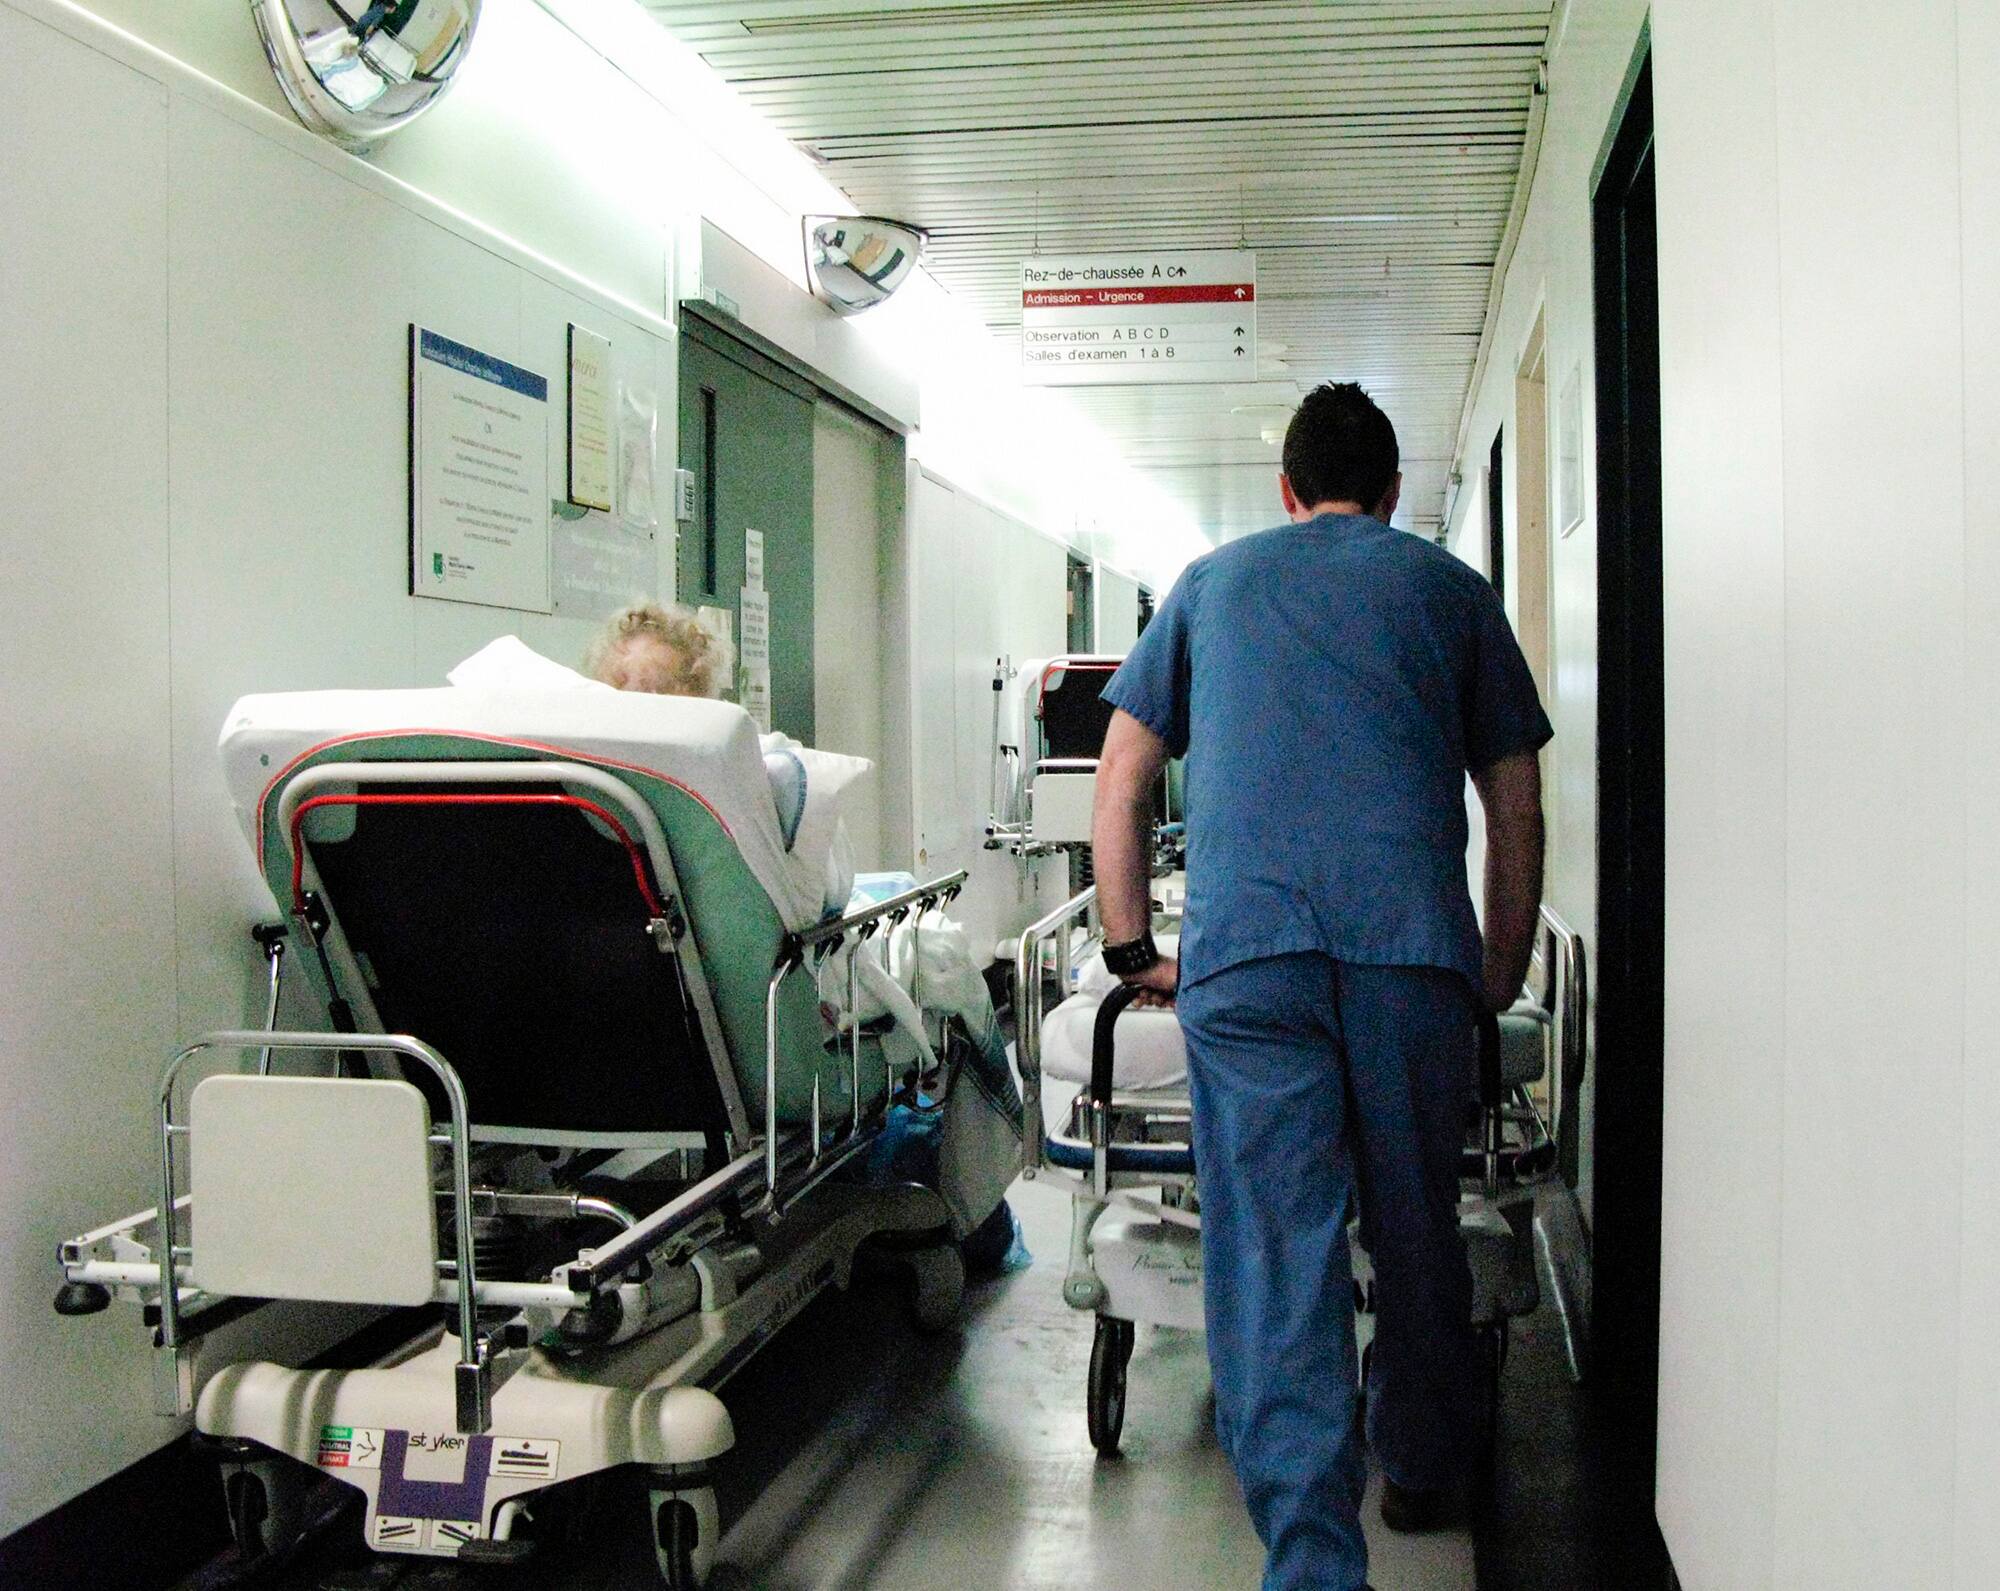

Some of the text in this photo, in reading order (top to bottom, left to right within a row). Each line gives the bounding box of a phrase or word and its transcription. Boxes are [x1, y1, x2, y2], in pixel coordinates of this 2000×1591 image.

[1024, 264, 1177, 282] Rez-de-chaussée A C
[1025, 293, 1081, 305] Admission
[1098, 291, 1145, 304] Urgence
[1025, 327, 1169, 343] Observation A B C D
[1025, 350, 1062, 362] Salles
[1068, 349, 1127, 361] d'examen
[1151, 348, 1159, 358] à
[408, 1431, 465, 1453] styker
